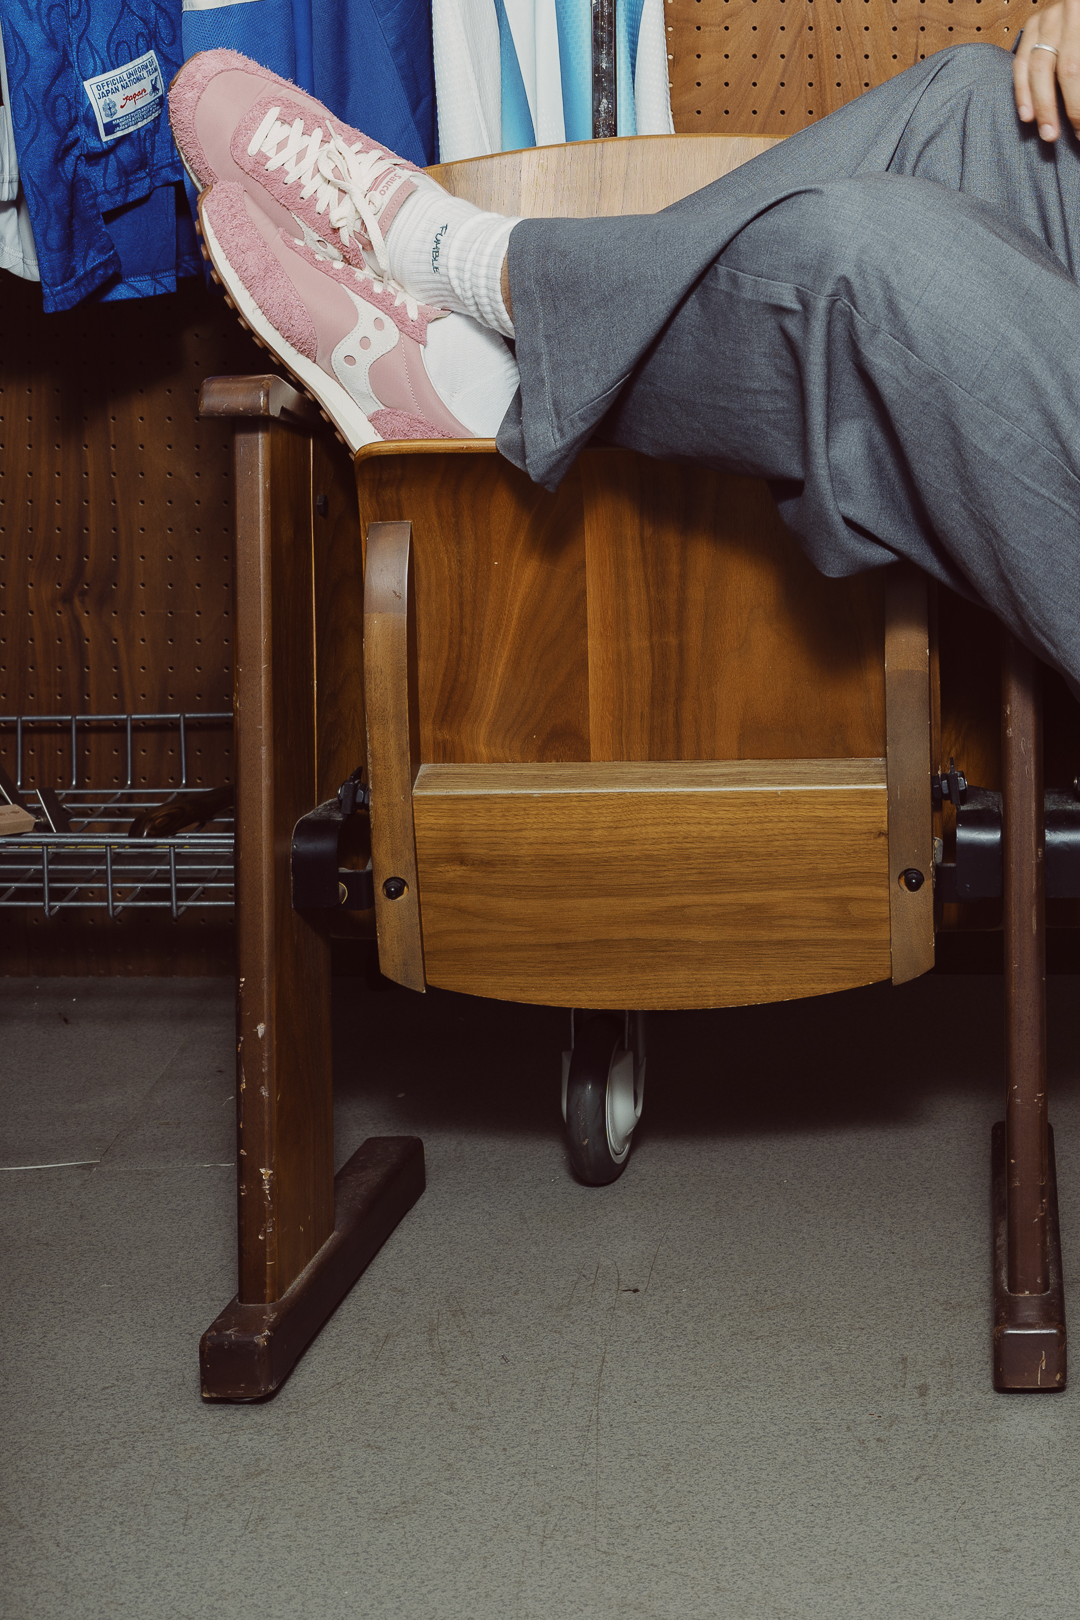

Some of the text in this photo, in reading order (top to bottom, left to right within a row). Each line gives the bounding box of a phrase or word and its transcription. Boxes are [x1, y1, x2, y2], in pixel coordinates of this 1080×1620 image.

[96, 59, 155, 91] OFFICIAL UNIFORM OF
[97, 84, 120, 100] JAPAN
[120, 74, 146, 92] NATIONAL
[379, 173, 402, 196] Sauco
[431, 223, 448, 273] FUMBLE
